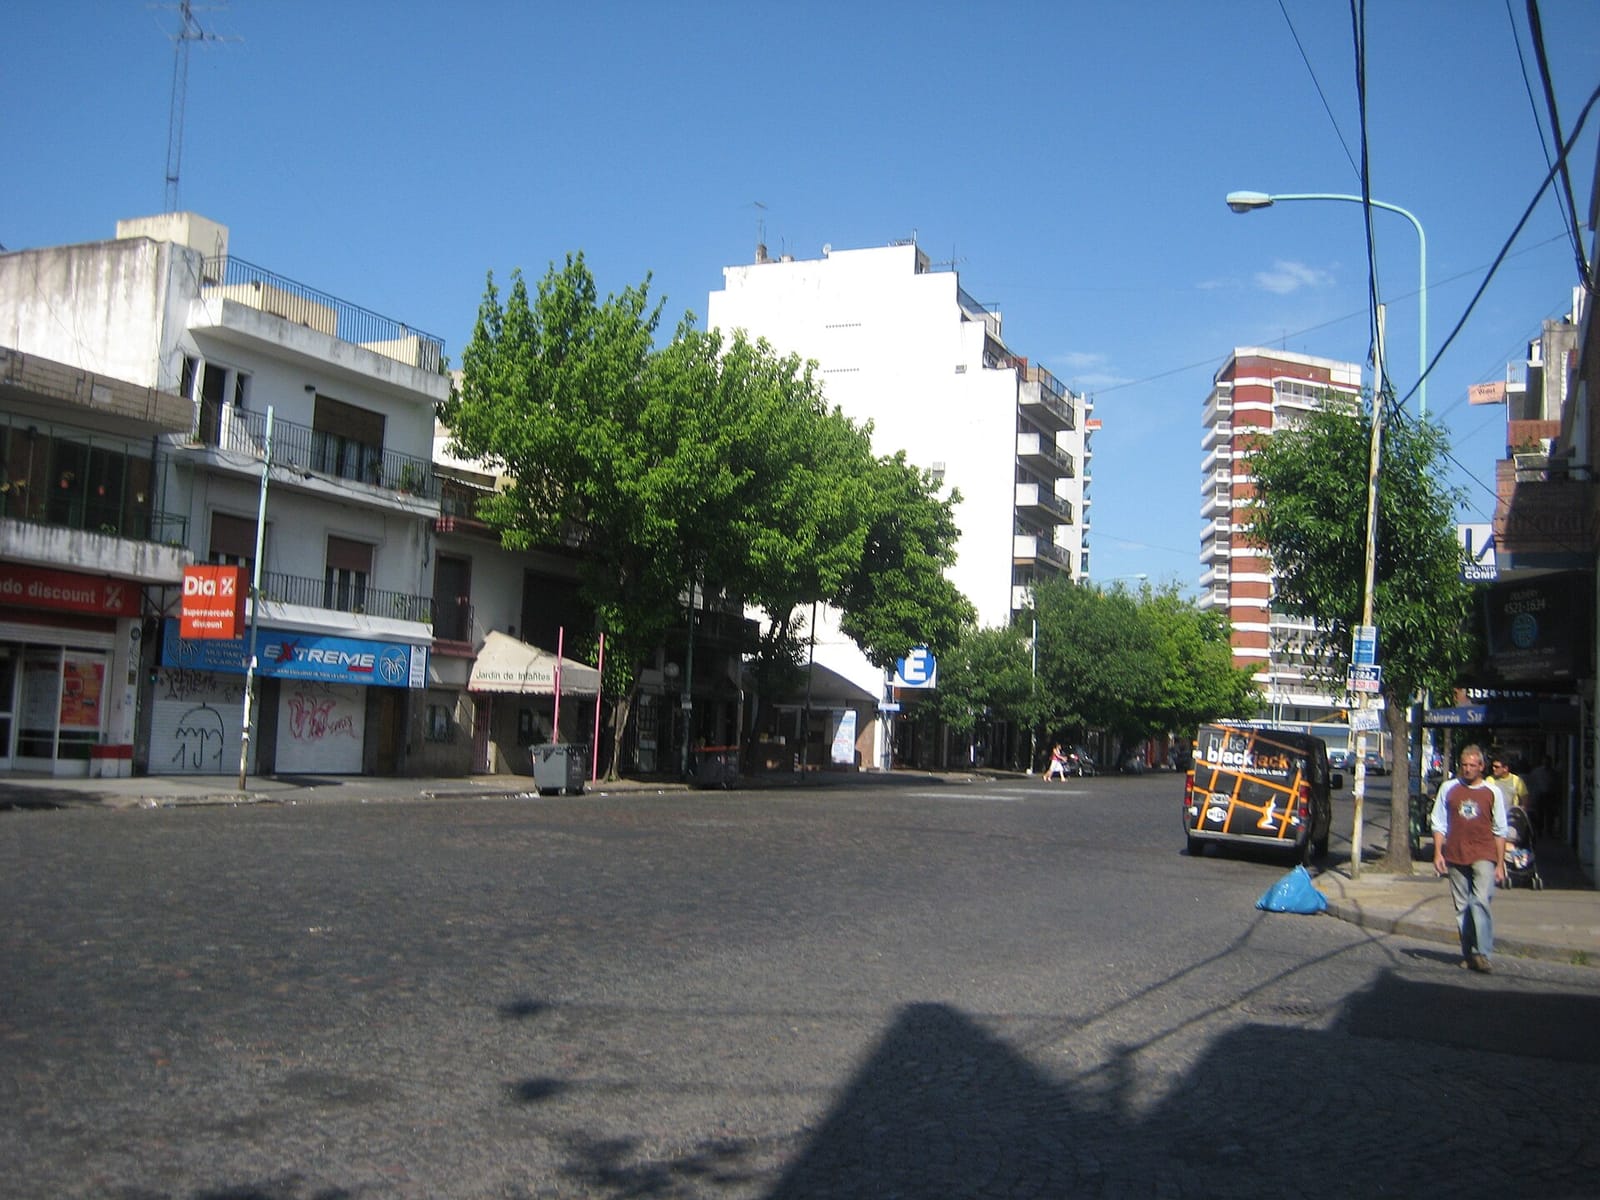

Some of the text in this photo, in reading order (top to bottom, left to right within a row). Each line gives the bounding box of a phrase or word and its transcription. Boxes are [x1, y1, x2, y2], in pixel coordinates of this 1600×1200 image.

[0, 577, 23, 594] do
[28, 581, 97, 604] discount
[184, 576, 217, 596] Dia
[182, 607, 234, 618] Supermercado
[192, 619, 224, 629] discount
[263, 640, 376, 668] EXTREME
[904, 649, 928, 681] E
[503, 671, 514, 681] de
[518, 671, 551, 681] Infantes
